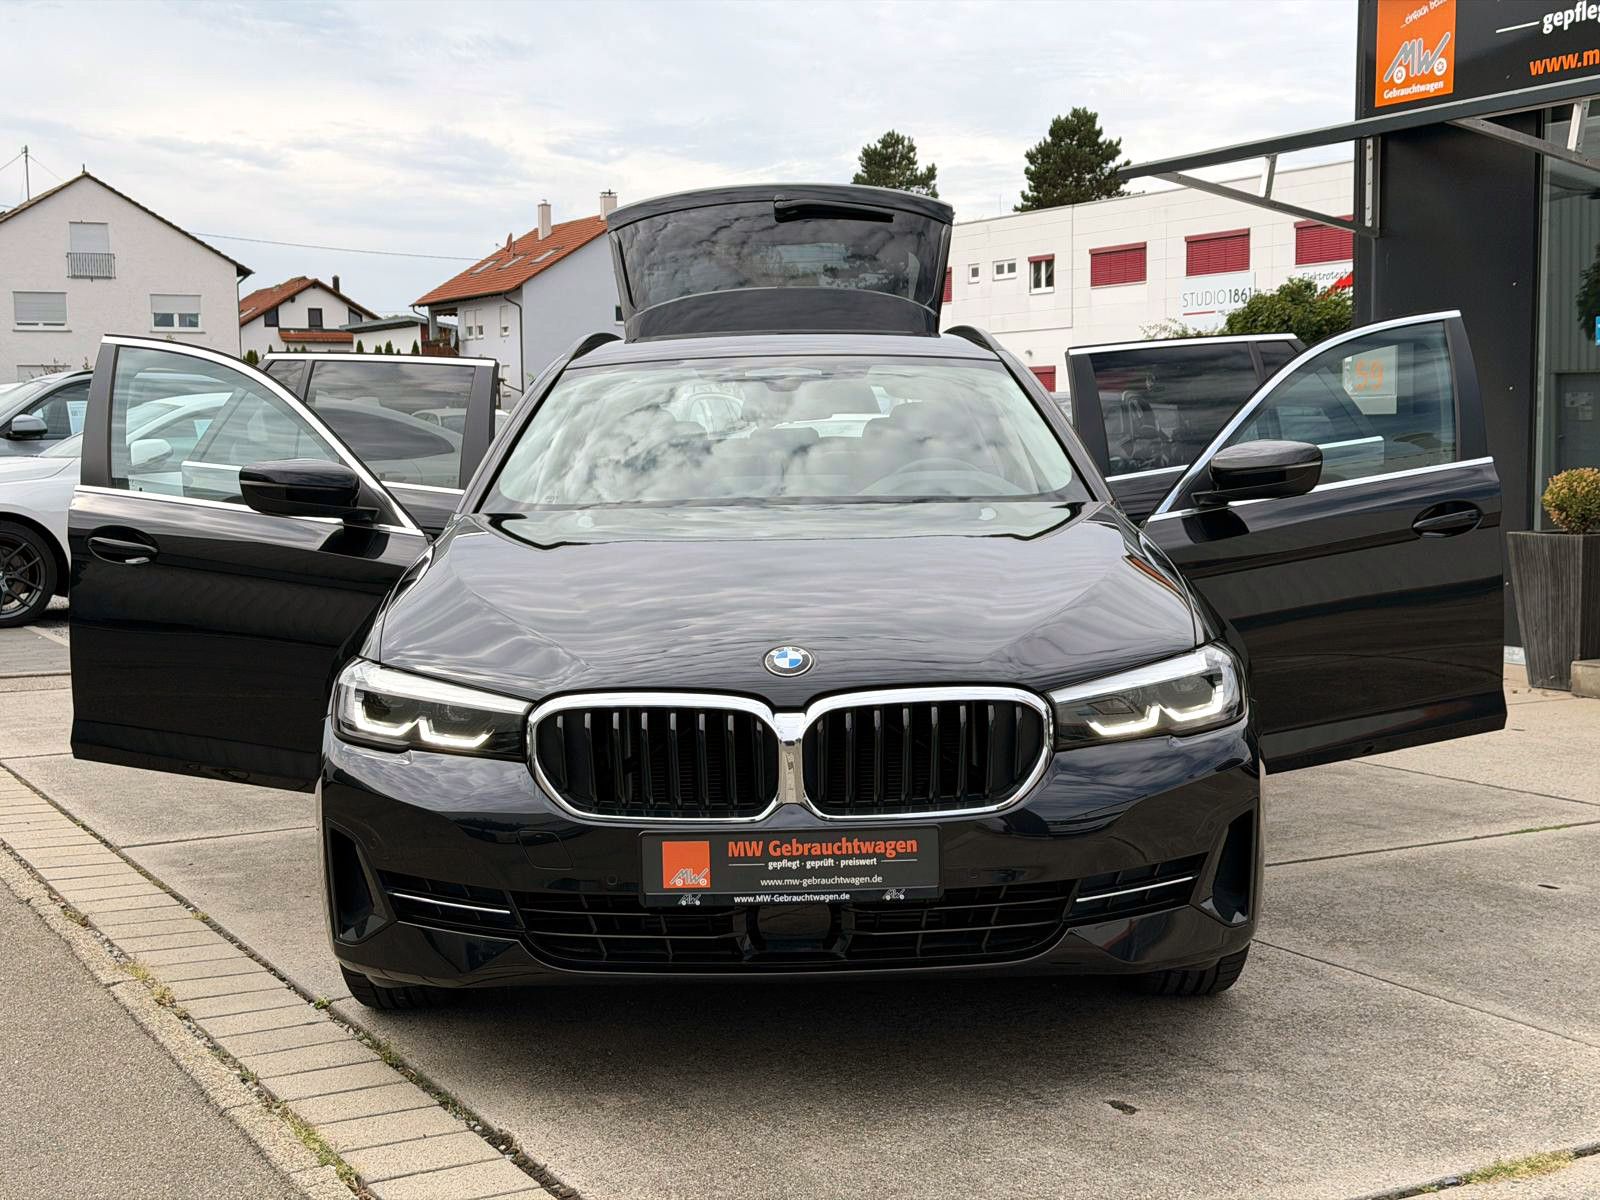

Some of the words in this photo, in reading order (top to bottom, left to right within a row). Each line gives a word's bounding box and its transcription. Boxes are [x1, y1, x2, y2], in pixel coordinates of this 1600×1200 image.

[1542, 0, 1600, 35] gepfle
[1383, 80, 1444, 99] Gebrauchtwagen
[728, 840, 763, 858] MW
[768, 837, 918, 858] Gebrauchtwagen
[767, 859, 800, 870] gepflegt
[805, 858, 835, 869] geprüft
[840, 857, 878, 869] preiswert
[760, 874, 883, 888] www.mw-gebrauchtwagen.de
[733, 892, 851, 904] www.MW-Gebrauchtwagen.de
